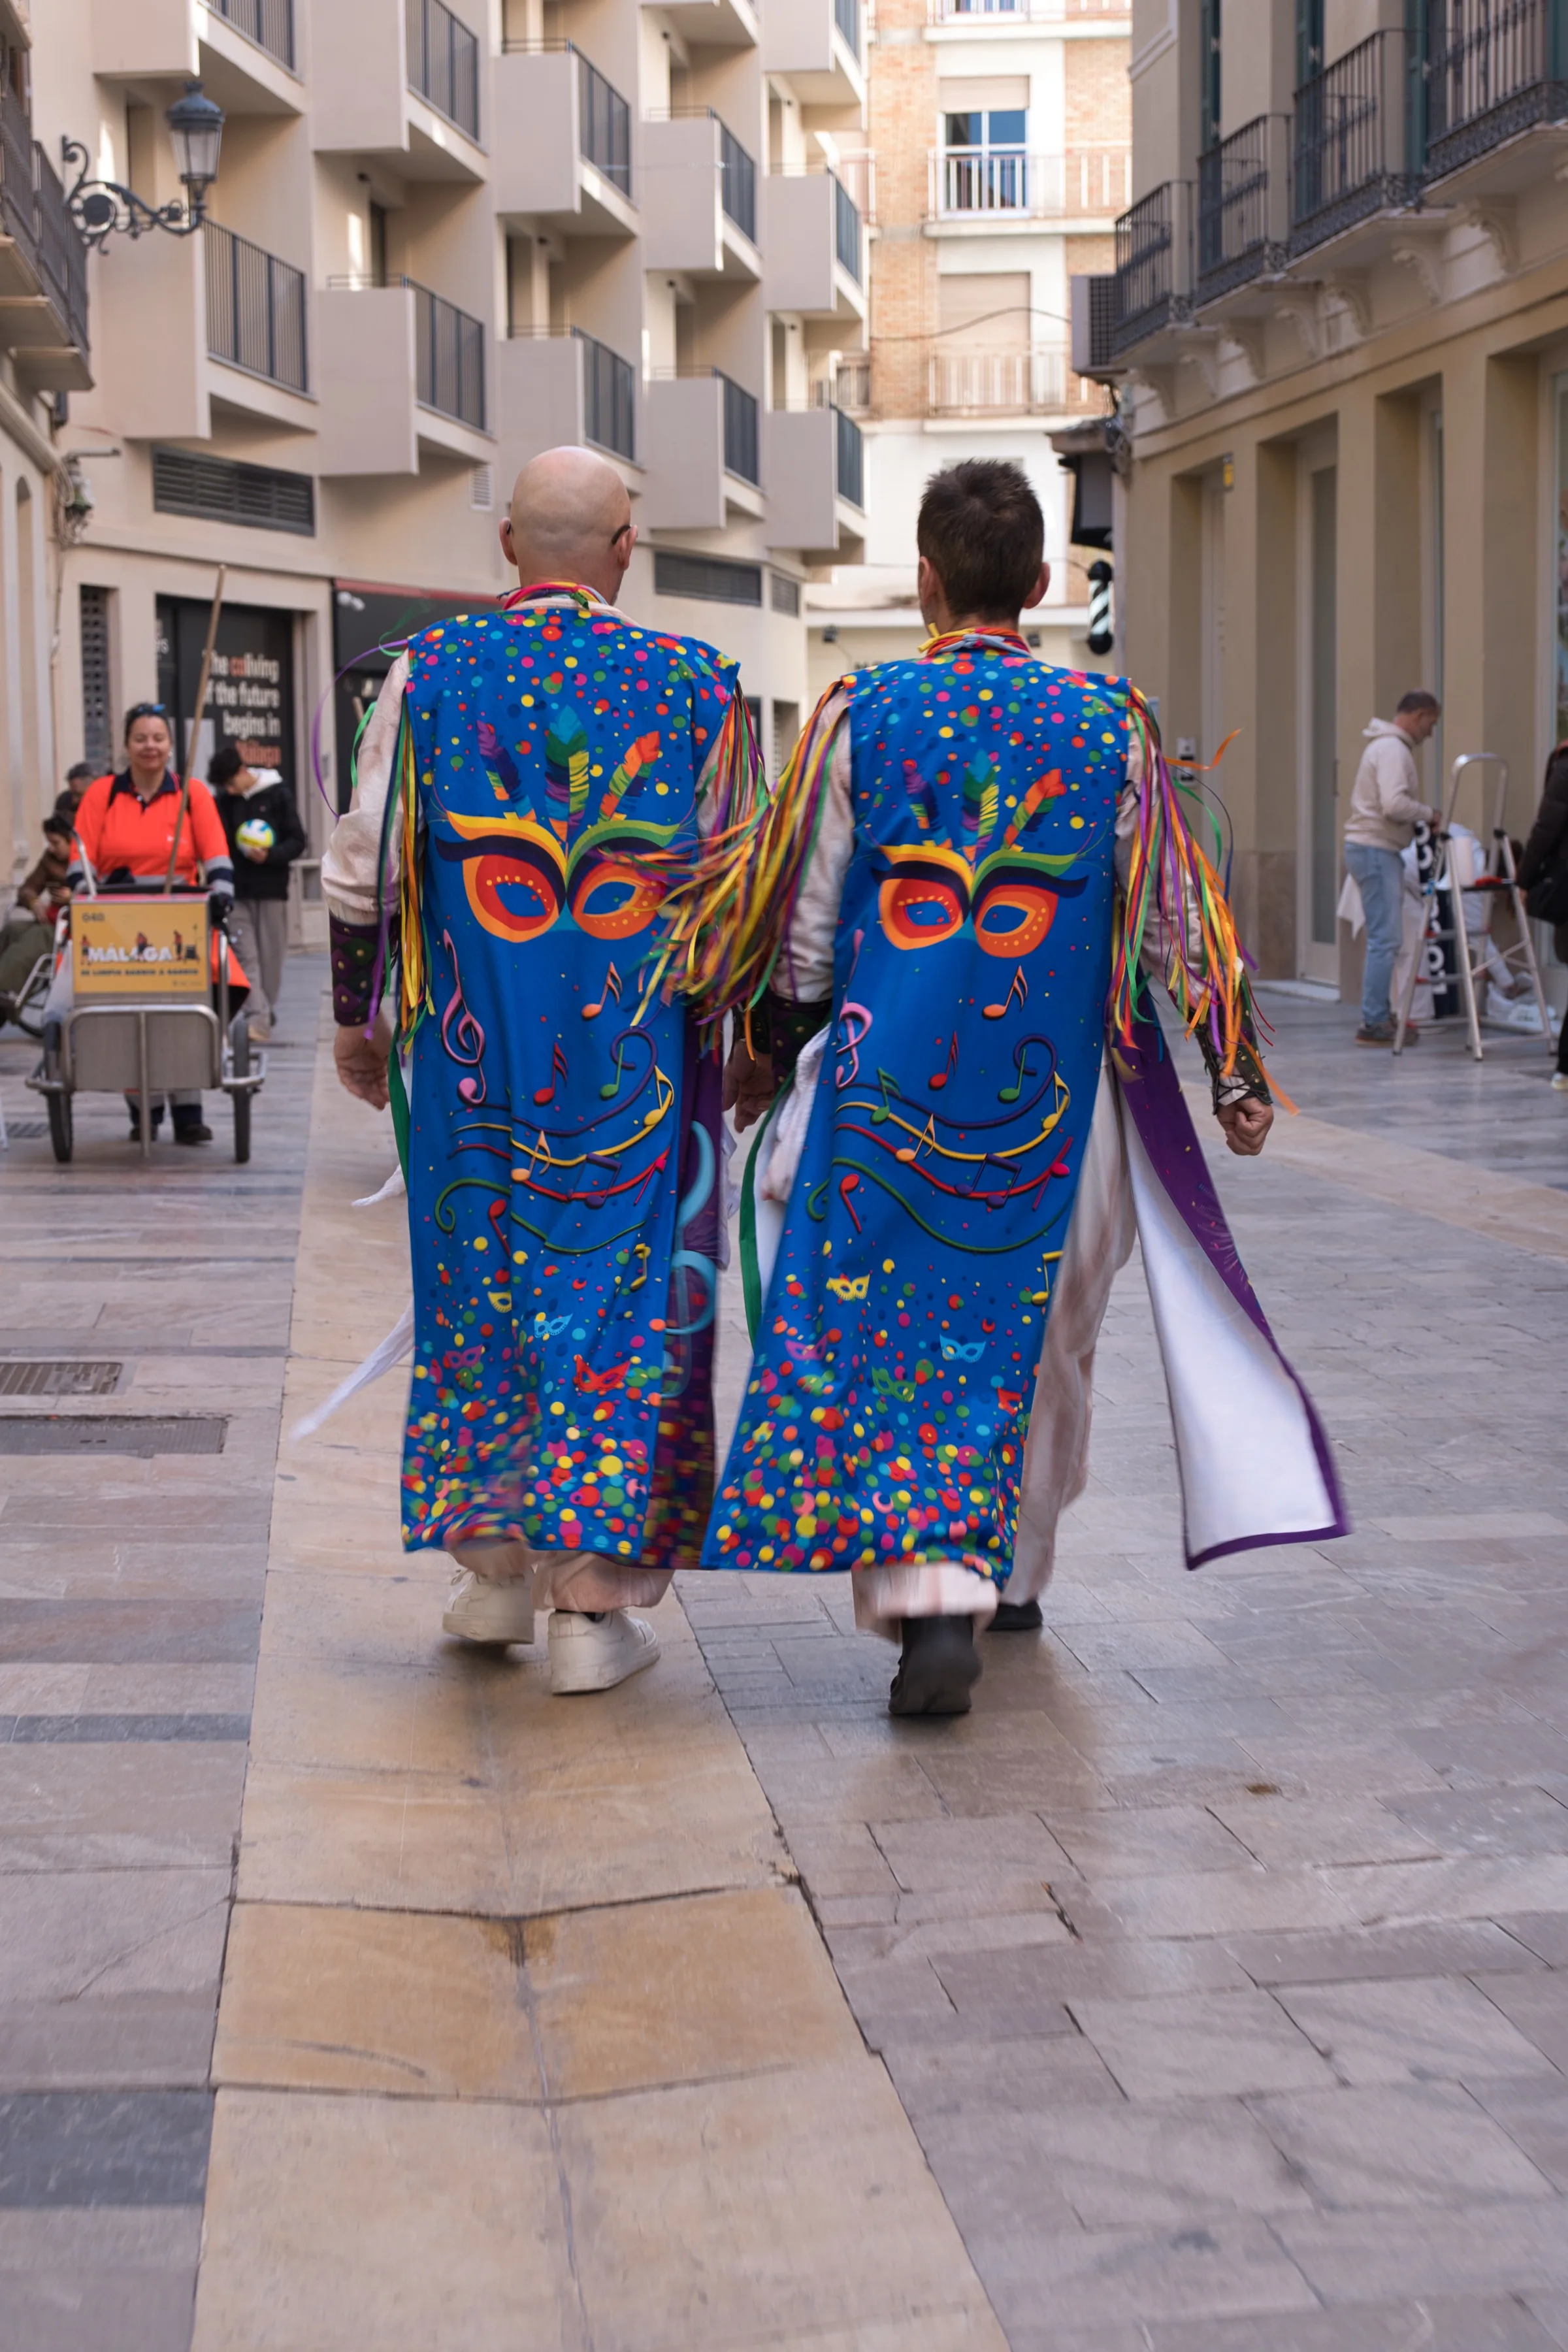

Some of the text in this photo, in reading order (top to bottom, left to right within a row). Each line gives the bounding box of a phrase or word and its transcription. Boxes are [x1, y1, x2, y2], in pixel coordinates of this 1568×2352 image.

[230, 652, 280, 683] coliving
[216, 680, 237, 706] the
[239, 680, 280, 708] future
[223, 710, 281, 740] begins in
[88, 943, 172, 962] MÁLAGA
